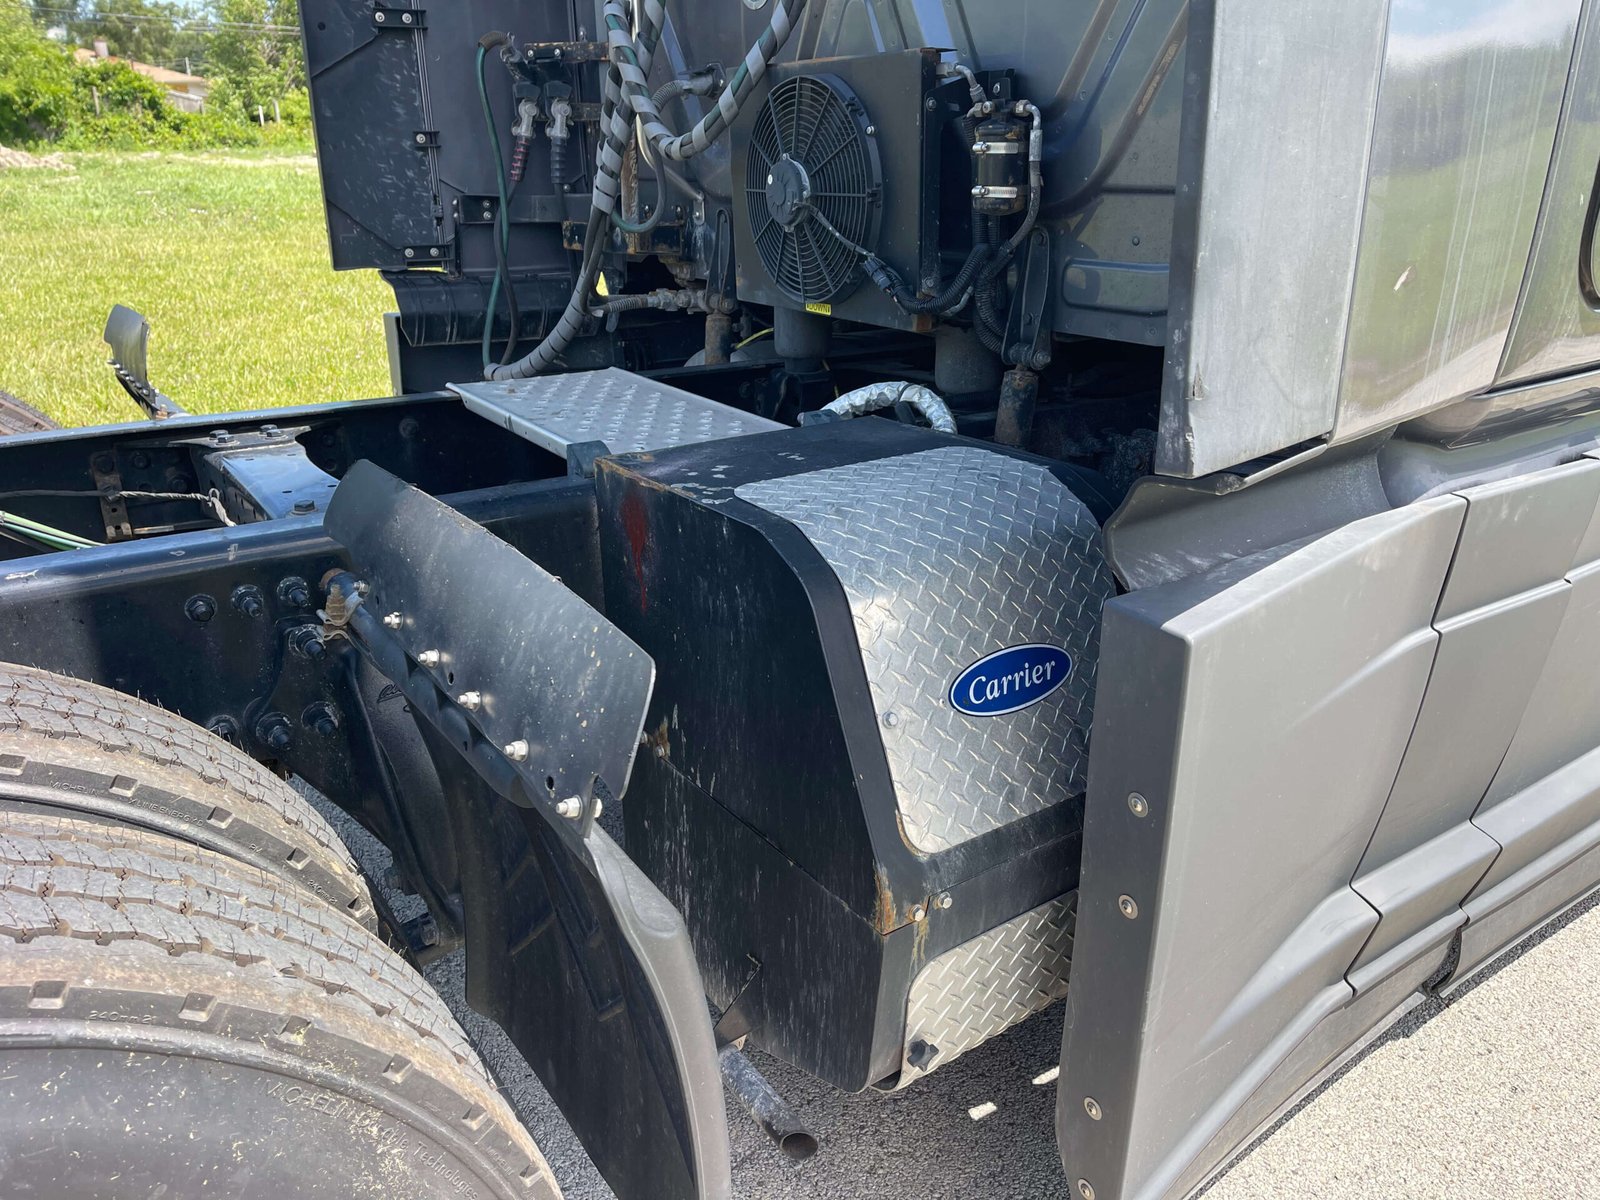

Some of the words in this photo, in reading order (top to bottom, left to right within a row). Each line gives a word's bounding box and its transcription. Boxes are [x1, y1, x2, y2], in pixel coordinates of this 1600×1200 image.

[969, 660, 1056, 704] Carrier
[89, 1010, 138, 1022] 240mm
[413, 1141, 479, 1200] Technologies
